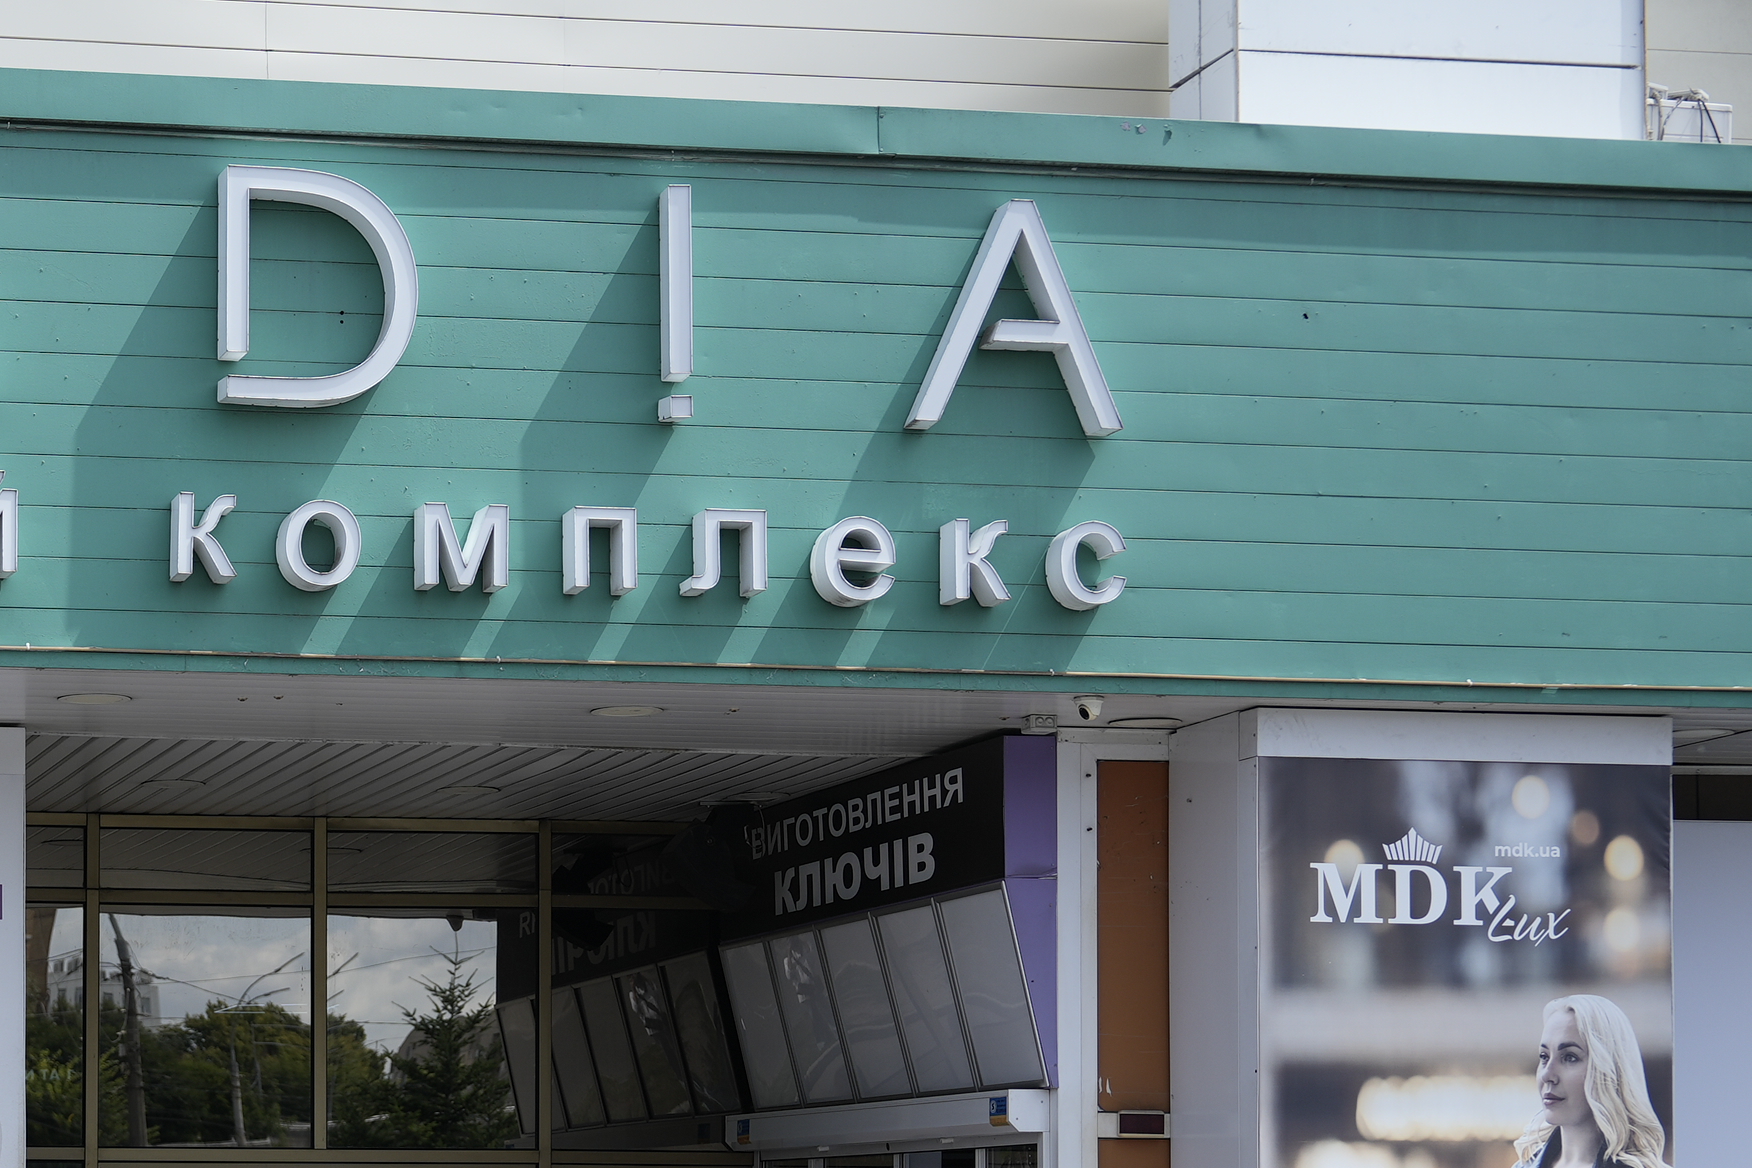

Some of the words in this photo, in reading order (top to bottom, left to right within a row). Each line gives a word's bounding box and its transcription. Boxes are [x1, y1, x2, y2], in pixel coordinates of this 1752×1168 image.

[170, 491, 1128, 612] комплекс
[751, 767, 964, 860] ВИГОТОВЛЕННЯ
[1494, 842, 1561, 858] mdk.ua
[774, 832, 936, 916] КЛЮЧІВ
[1309, 862, 1513, 927] MDK
[1487, 895, 1571, 947] Lux
